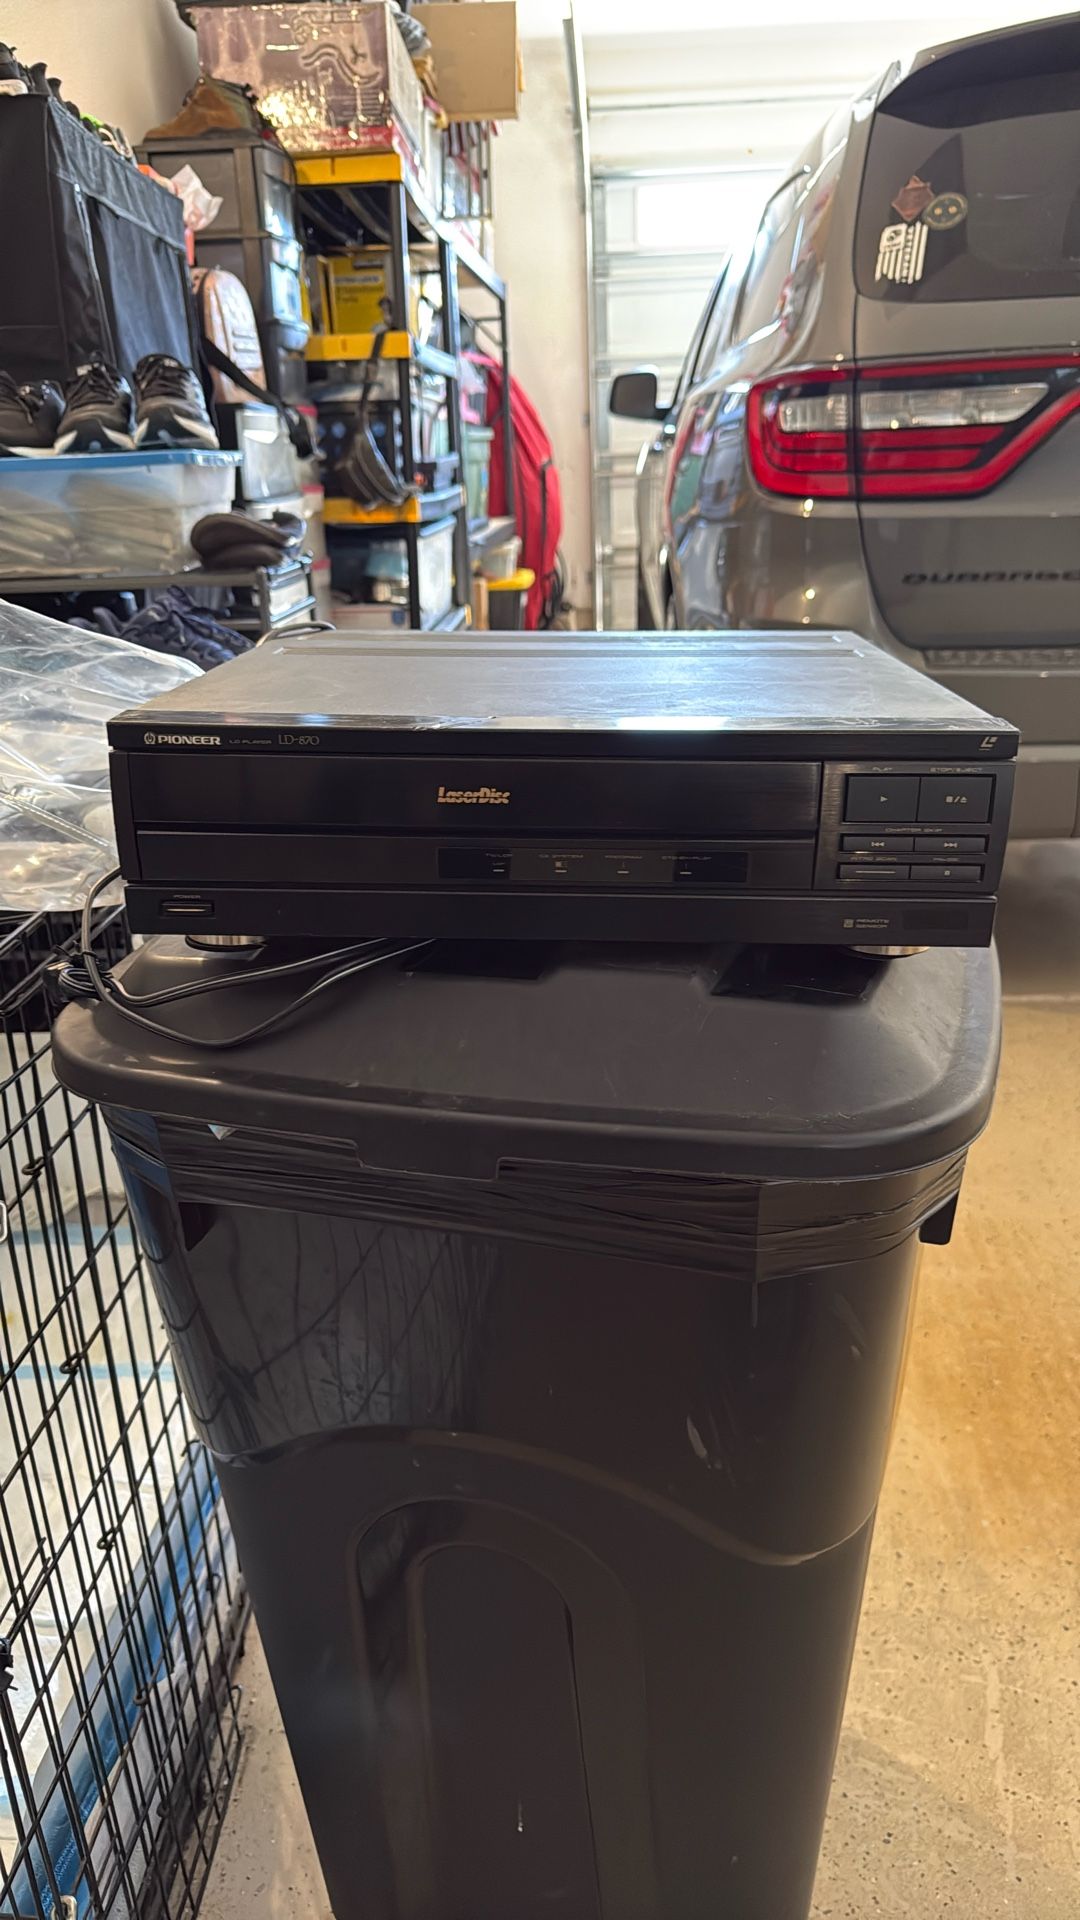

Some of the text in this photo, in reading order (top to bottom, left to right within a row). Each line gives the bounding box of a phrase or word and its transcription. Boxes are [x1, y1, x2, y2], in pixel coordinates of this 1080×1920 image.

[157, 734, 221, 746] PIONEER
[278, 734, 320, 746] LD-870
[437, 786, 511, 804] LaserDisc
